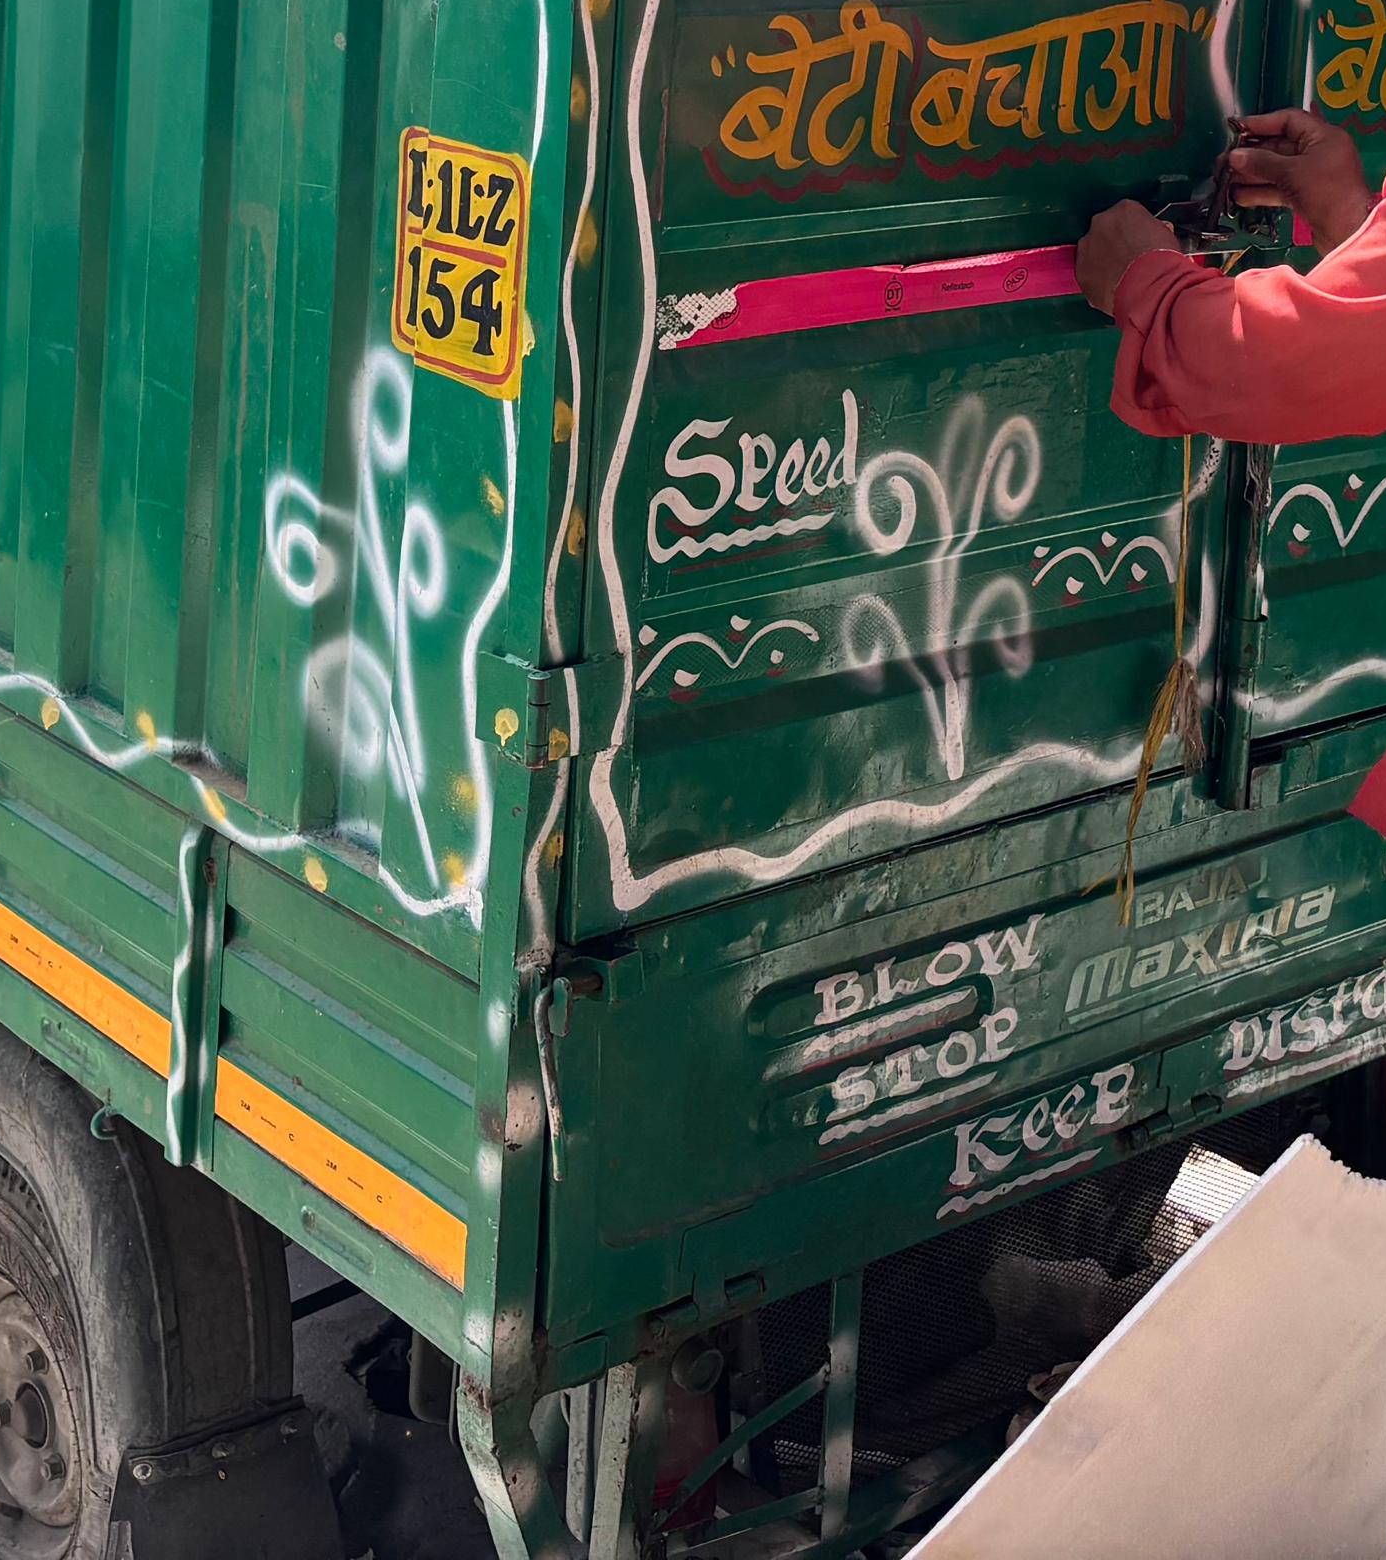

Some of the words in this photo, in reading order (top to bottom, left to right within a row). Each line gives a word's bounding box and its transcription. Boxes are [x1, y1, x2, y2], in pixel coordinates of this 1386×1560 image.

[406, 245, 504, 357] 154
[812, 912, 1044, 1027] BLOW
[826, 1007, 1020, 1122] STOP
